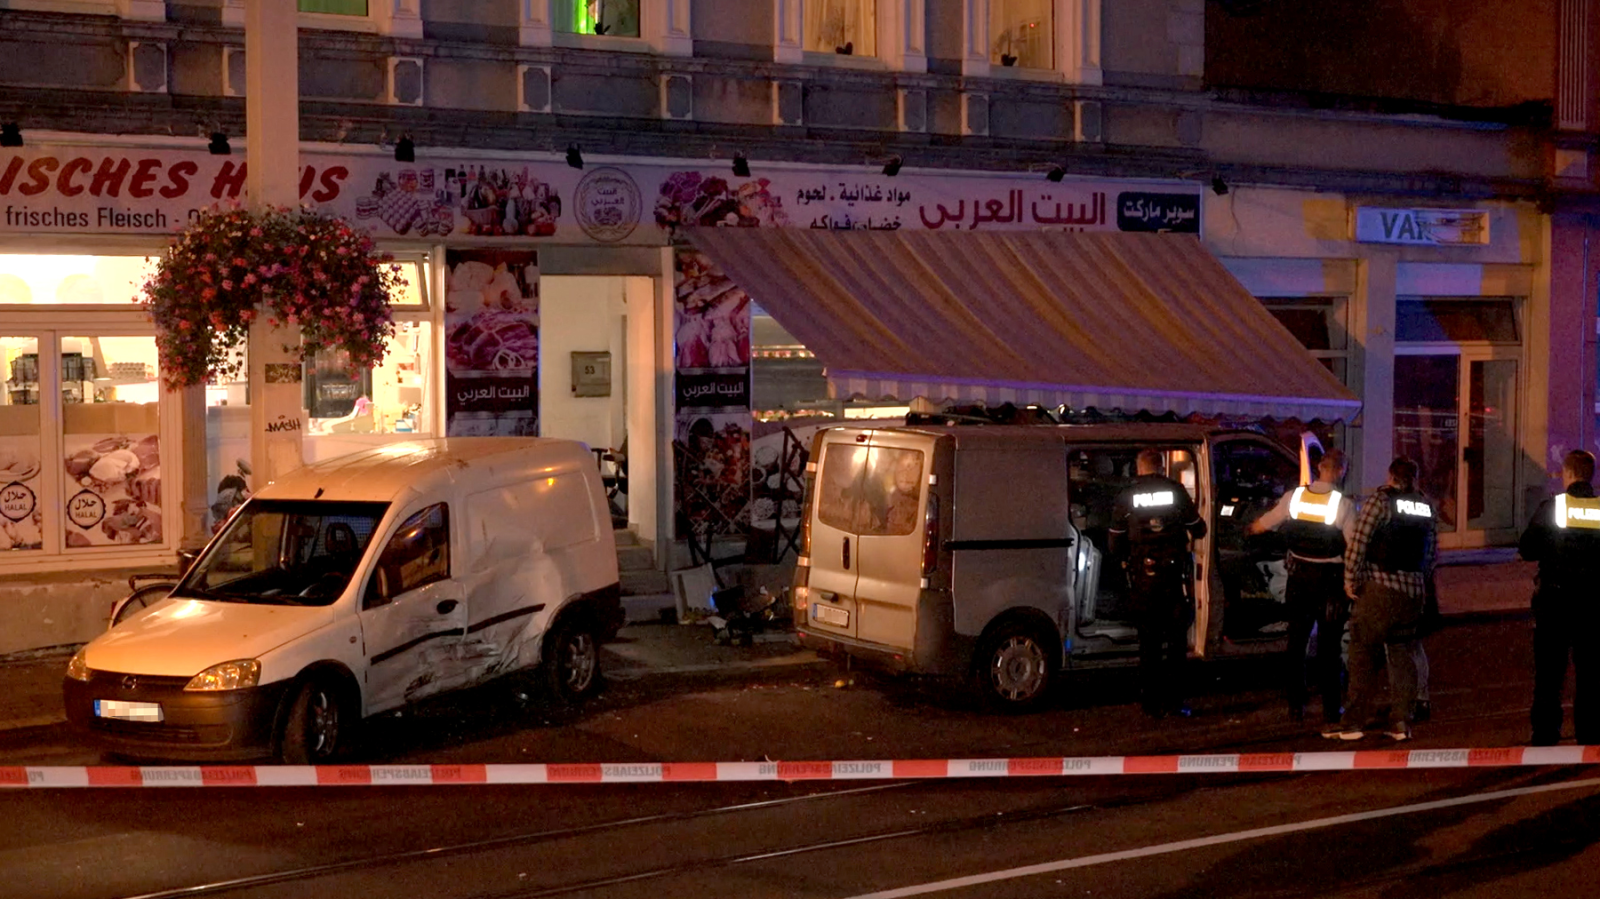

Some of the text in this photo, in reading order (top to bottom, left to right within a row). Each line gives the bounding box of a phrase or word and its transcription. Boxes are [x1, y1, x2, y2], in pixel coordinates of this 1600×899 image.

[797, 185, 827, 205] لحوم
[886, 187, 911, 206] مواد
[6, 205, 89, 227] frisches
[97, 207, 167, 228] Fleisch
[1032, 192, 1106, 233] البيت
[584, 365, 596, 375] 53
[457, 384, 530, 406] البيت العربي
[683, 381, 744, 401] البيت العربي
[4, 491, 27, 503] حلال
[75, 499, 97, 510] حلال
[1396, 499, 1432, 518] POLIZEI
